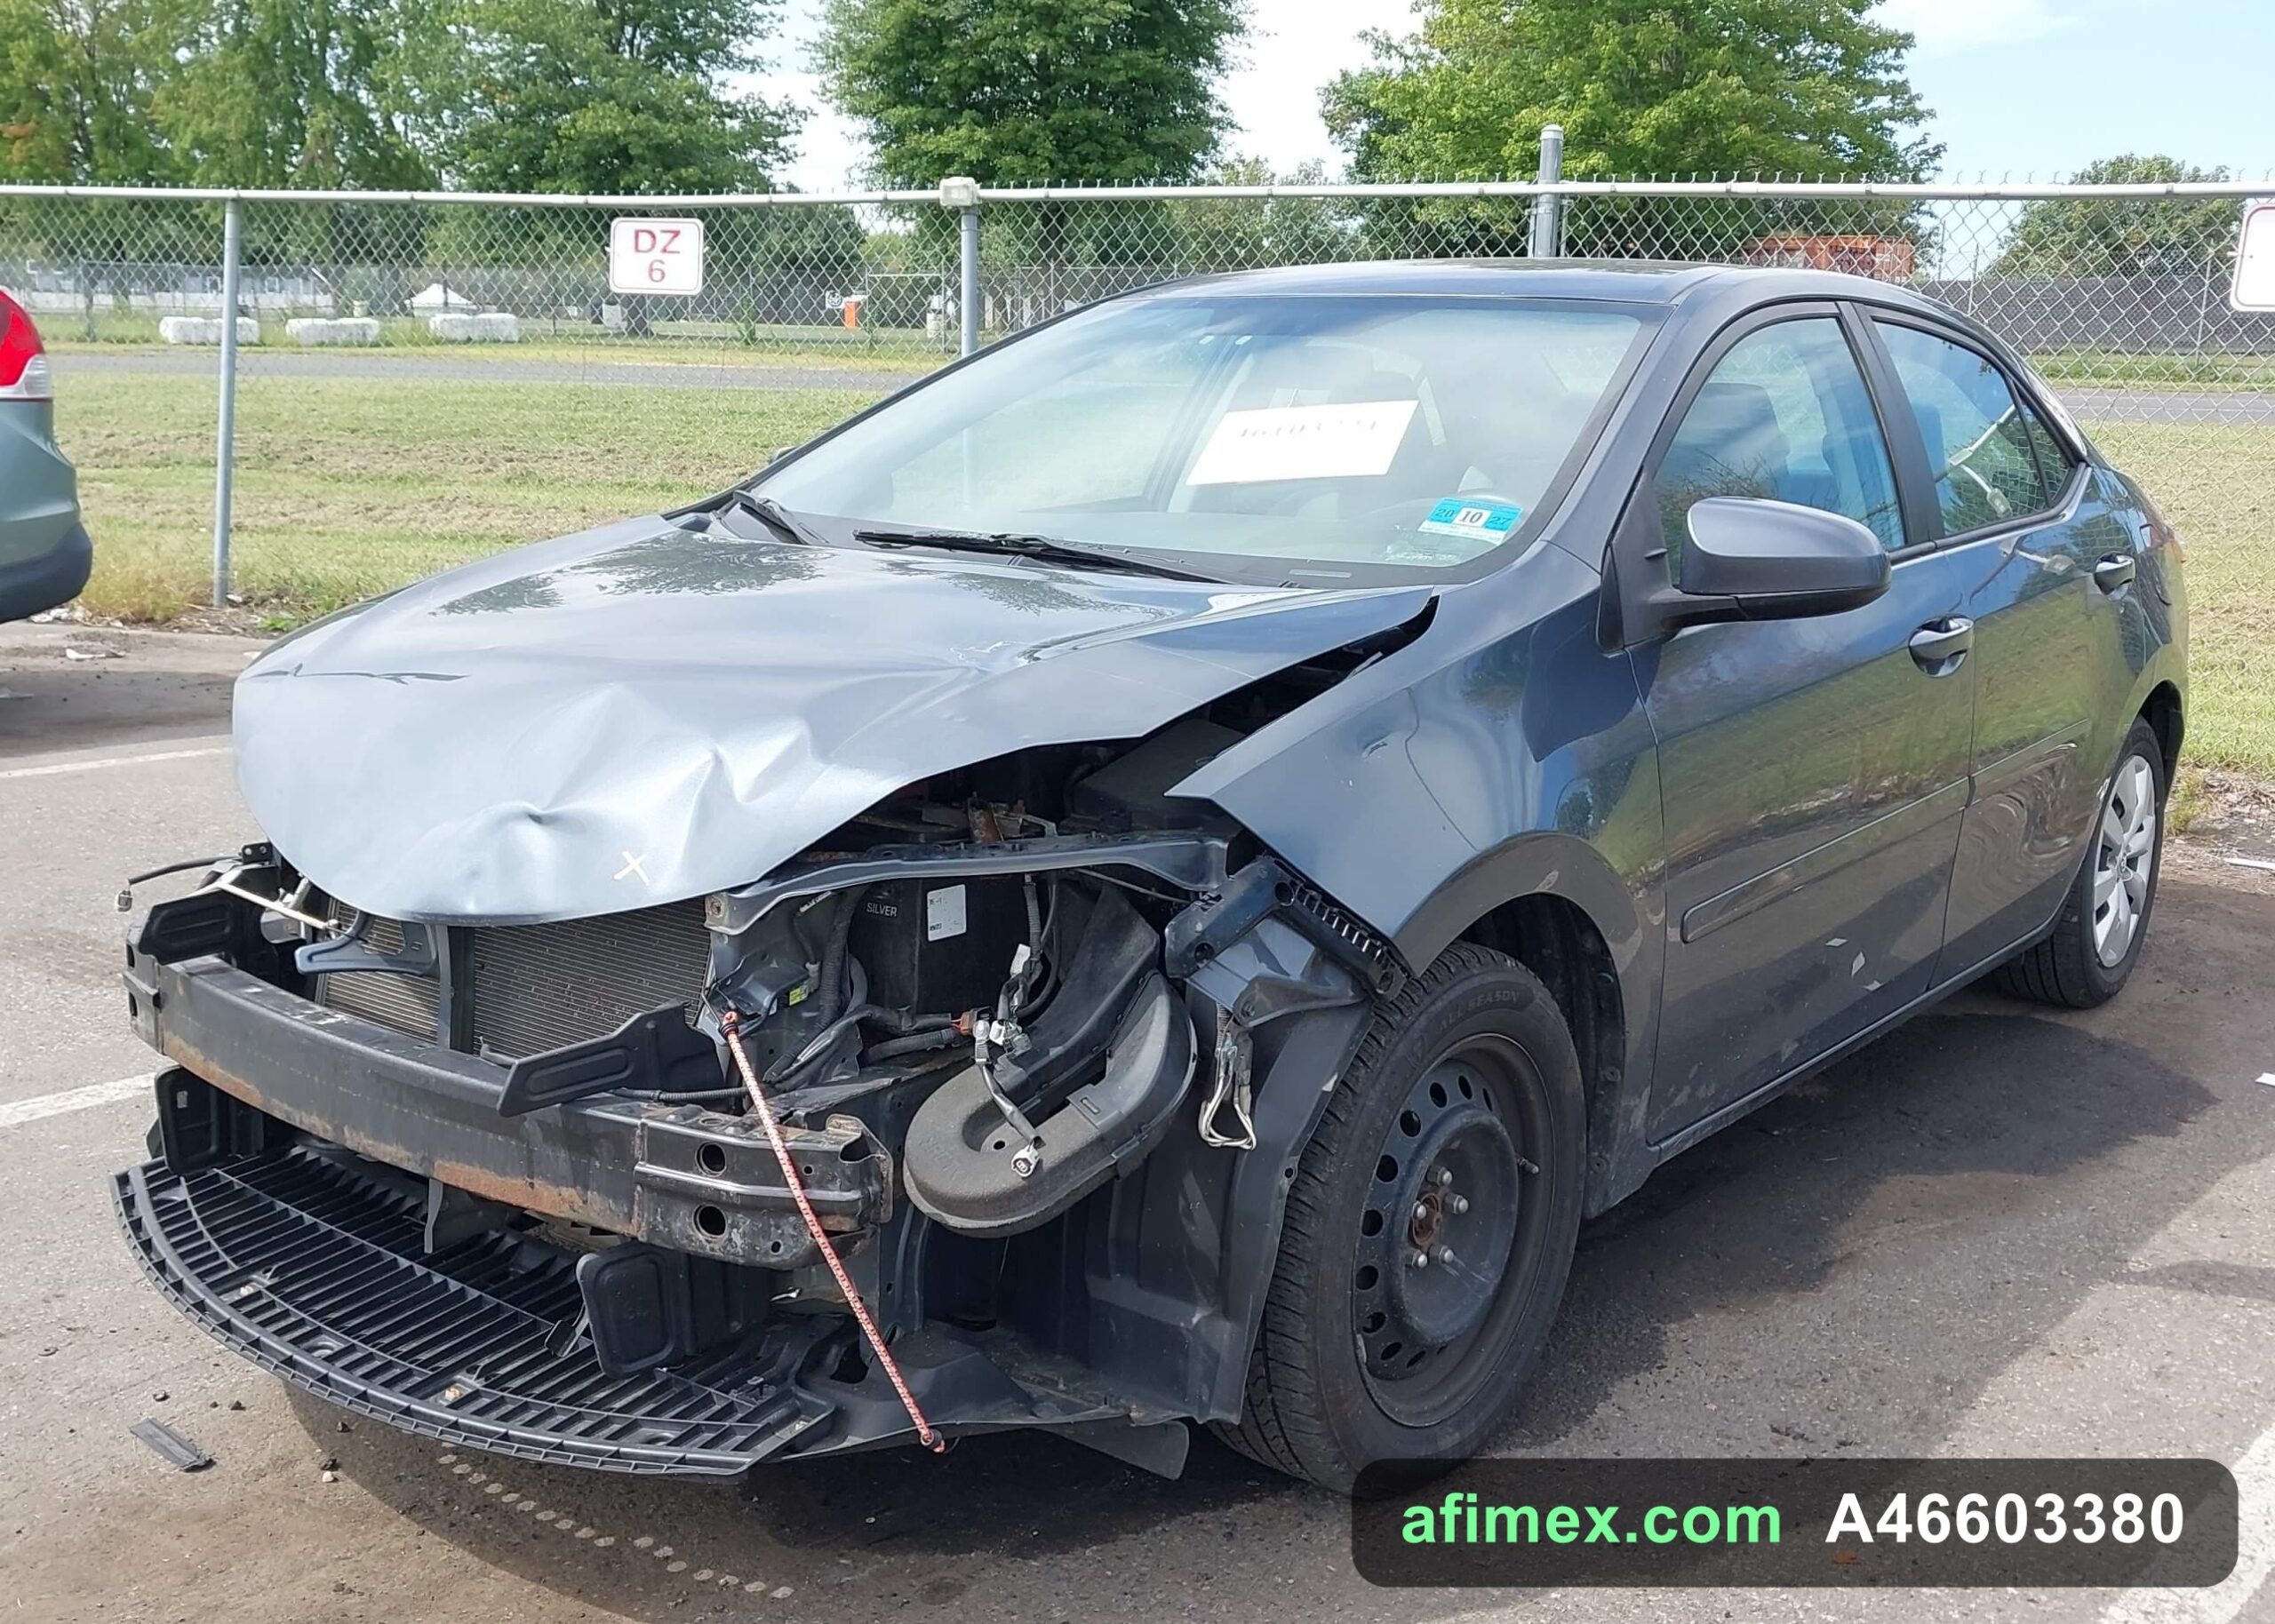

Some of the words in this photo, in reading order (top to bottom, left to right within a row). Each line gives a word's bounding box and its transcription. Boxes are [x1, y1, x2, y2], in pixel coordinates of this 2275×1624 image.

[634, 228, 681, 254] DZ
[648, 259, 666, 283] 6
[1459, 510, 1483, 523] 10
[866, 903, 898, 917] SILVER
[1440, 1009, 1464, 1031] ALL
[1469, 990, 1520, 1009] SEASON
